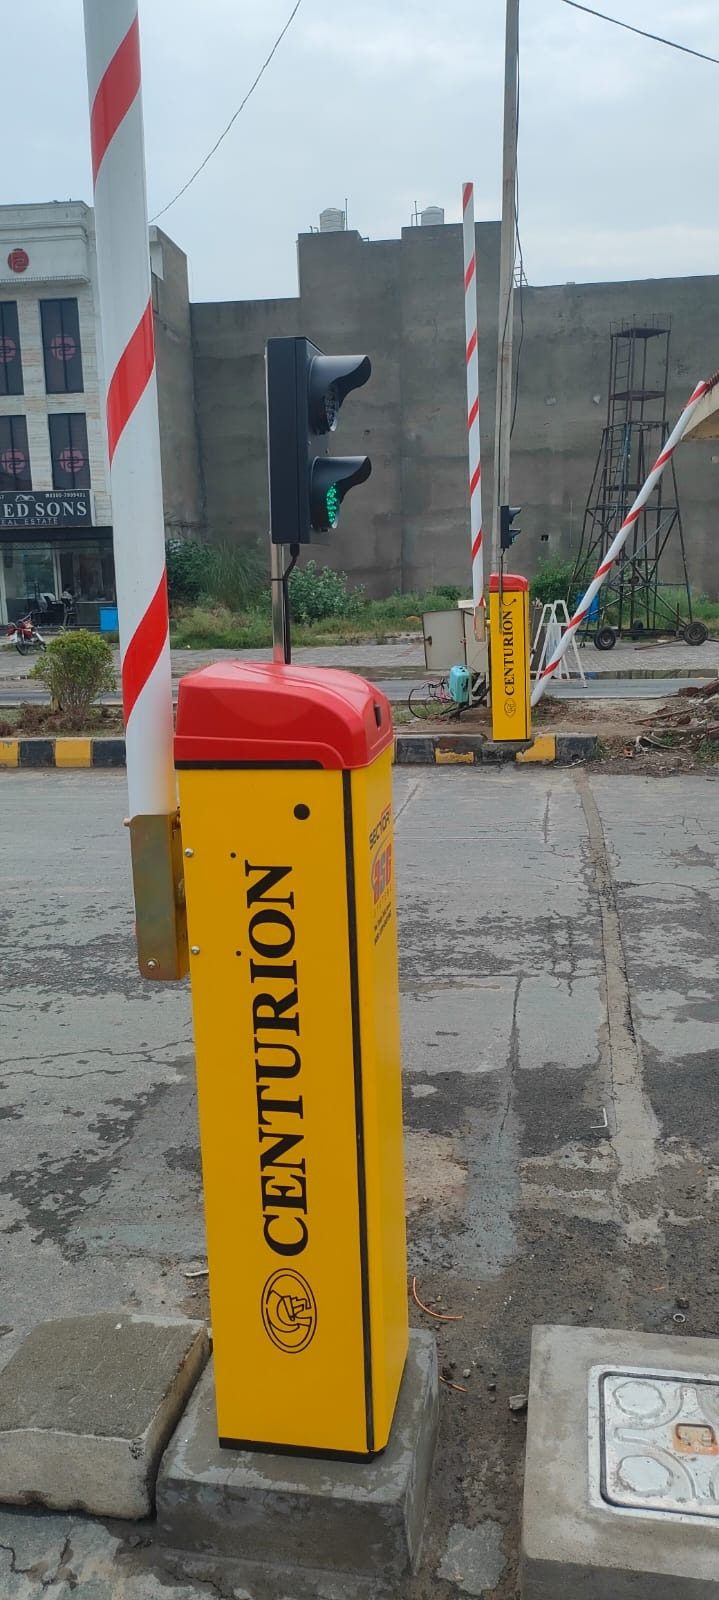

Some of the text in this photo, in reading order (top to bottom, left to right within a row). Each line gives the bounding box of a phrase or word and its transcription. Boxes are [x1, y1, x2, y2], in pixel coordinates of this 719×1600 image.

[0, 517, 58, 526] EAL ESTATE
[35, 501, 87, 517] SONS
[502, 611, 515, 696] CENTURION
[244, 860, 309, 1257] CENTURION
